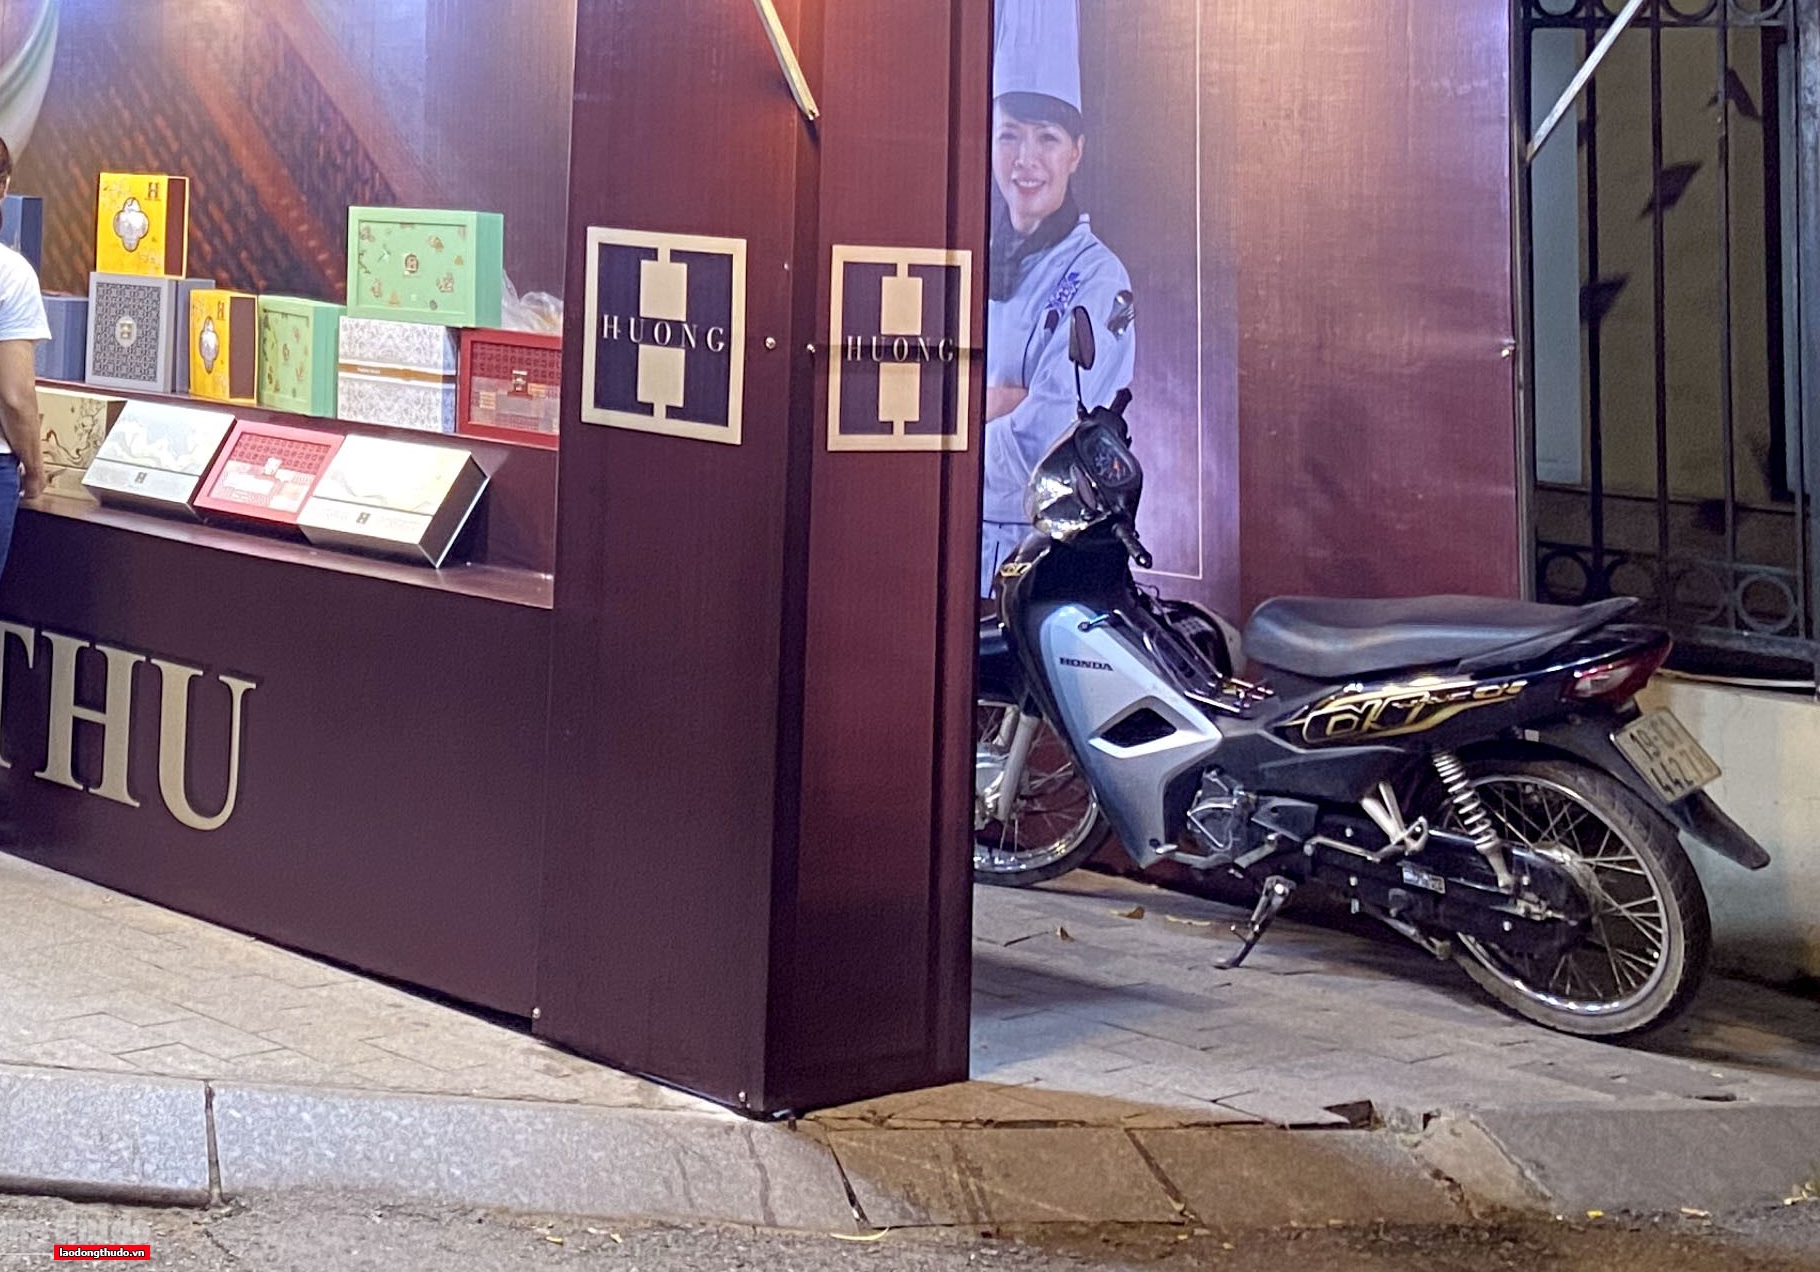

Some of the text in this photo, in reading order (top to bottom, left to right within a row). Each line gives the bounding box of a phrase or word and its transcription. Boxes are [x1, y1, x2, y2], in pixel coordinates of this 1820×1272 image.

[601, 313, 727, 353] HUONG
[845, 335, 955, 362] HUONG
[1058, 656, 1114, 672] HONDA
